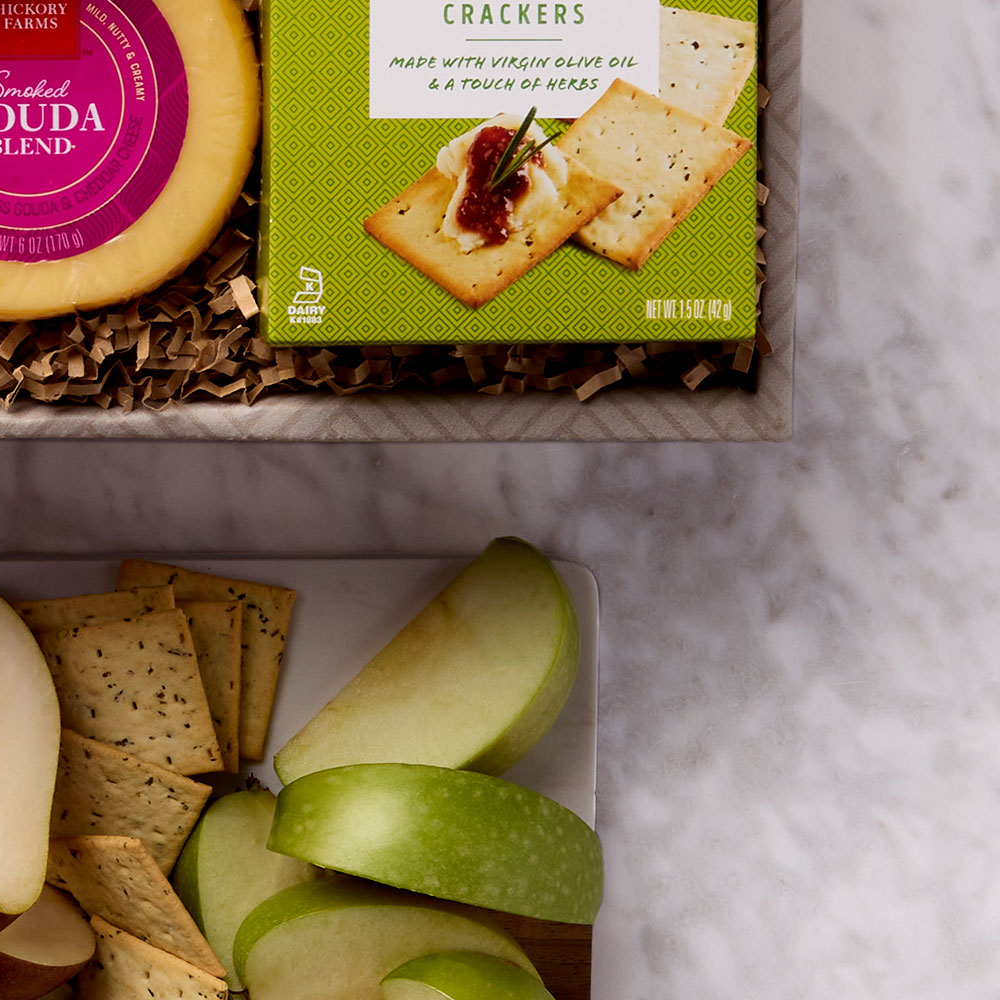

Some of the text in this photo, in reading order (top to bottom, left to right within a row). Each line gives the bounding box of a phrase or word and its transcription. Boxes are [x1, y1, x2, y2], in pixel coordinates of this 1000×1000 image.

[4, 18, 58, 30] FARMS
[443, 3, 585, 25] CRACKERS
[85, 3, 145, 102] MILD, NUTTY & CREAMY
[388, 56, 639, 71] MADE WITH VIRGIN OLIVE OIL
[428, 77, 599, 91] & A TOUCH OF HERBS
[13, 201, 59, 217] GOUDA
[60, 195, 73, 210] &
[73, 159, 124, 204] CHEDDAR
[116, 114, 143, 161] CHEESE
[0, 234, 15, 253] WT
[18, 236, 25, 254] 6
[29, 237, 43, 255] OZ
[45, 232, 70, 254] (170
[72, 228, 84, 249] g)
[287, 305, 326, 315] DAIRY
[646, 299, 661, 319] NET
[679, 299, 692, 319] 1.5
[708, 299, 722, 321] (42
[723, 299, 732, 321] g)
